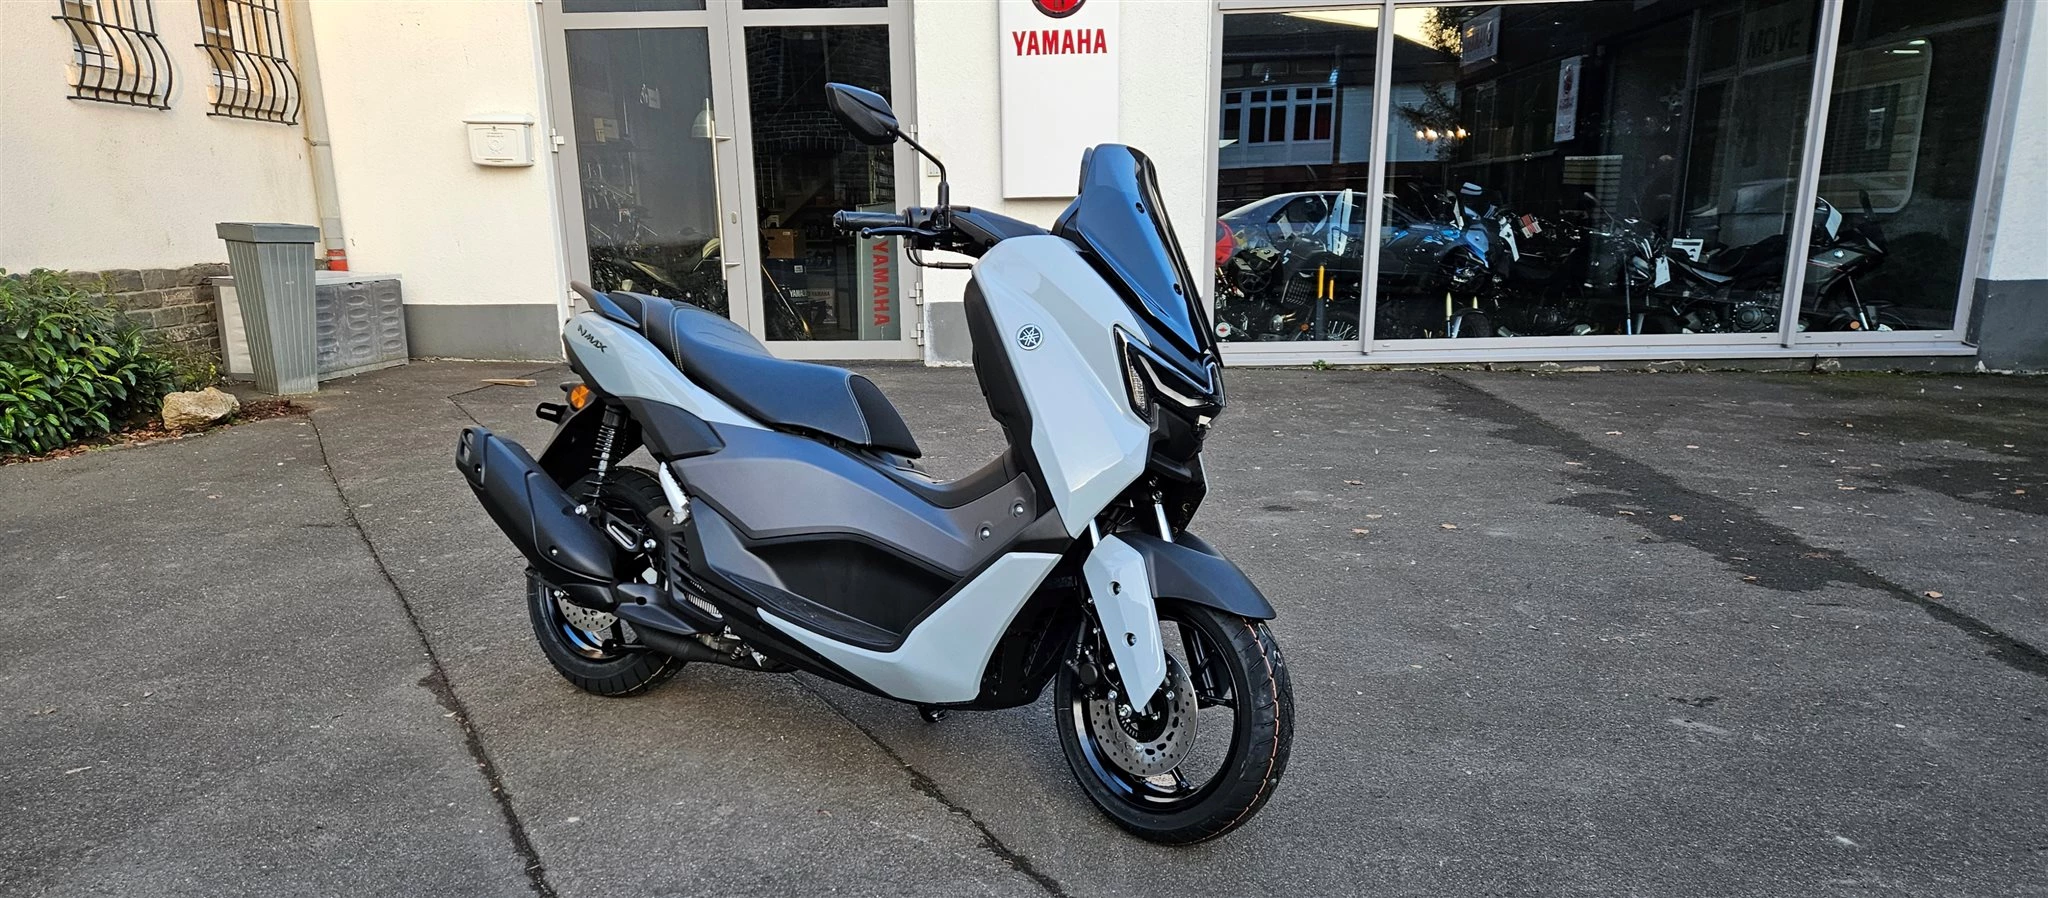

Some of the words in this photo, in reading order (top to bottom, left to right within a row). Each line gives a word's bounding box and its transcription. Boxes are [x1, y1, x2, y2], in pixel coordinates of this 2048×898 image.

[1012, 28, 1108, 56] YAMAHA
[1747, 20, 1802, 59] MOVE
[872, 240, 891, 327] YAMAHA
[577, 324, 608, 354] NMAX
